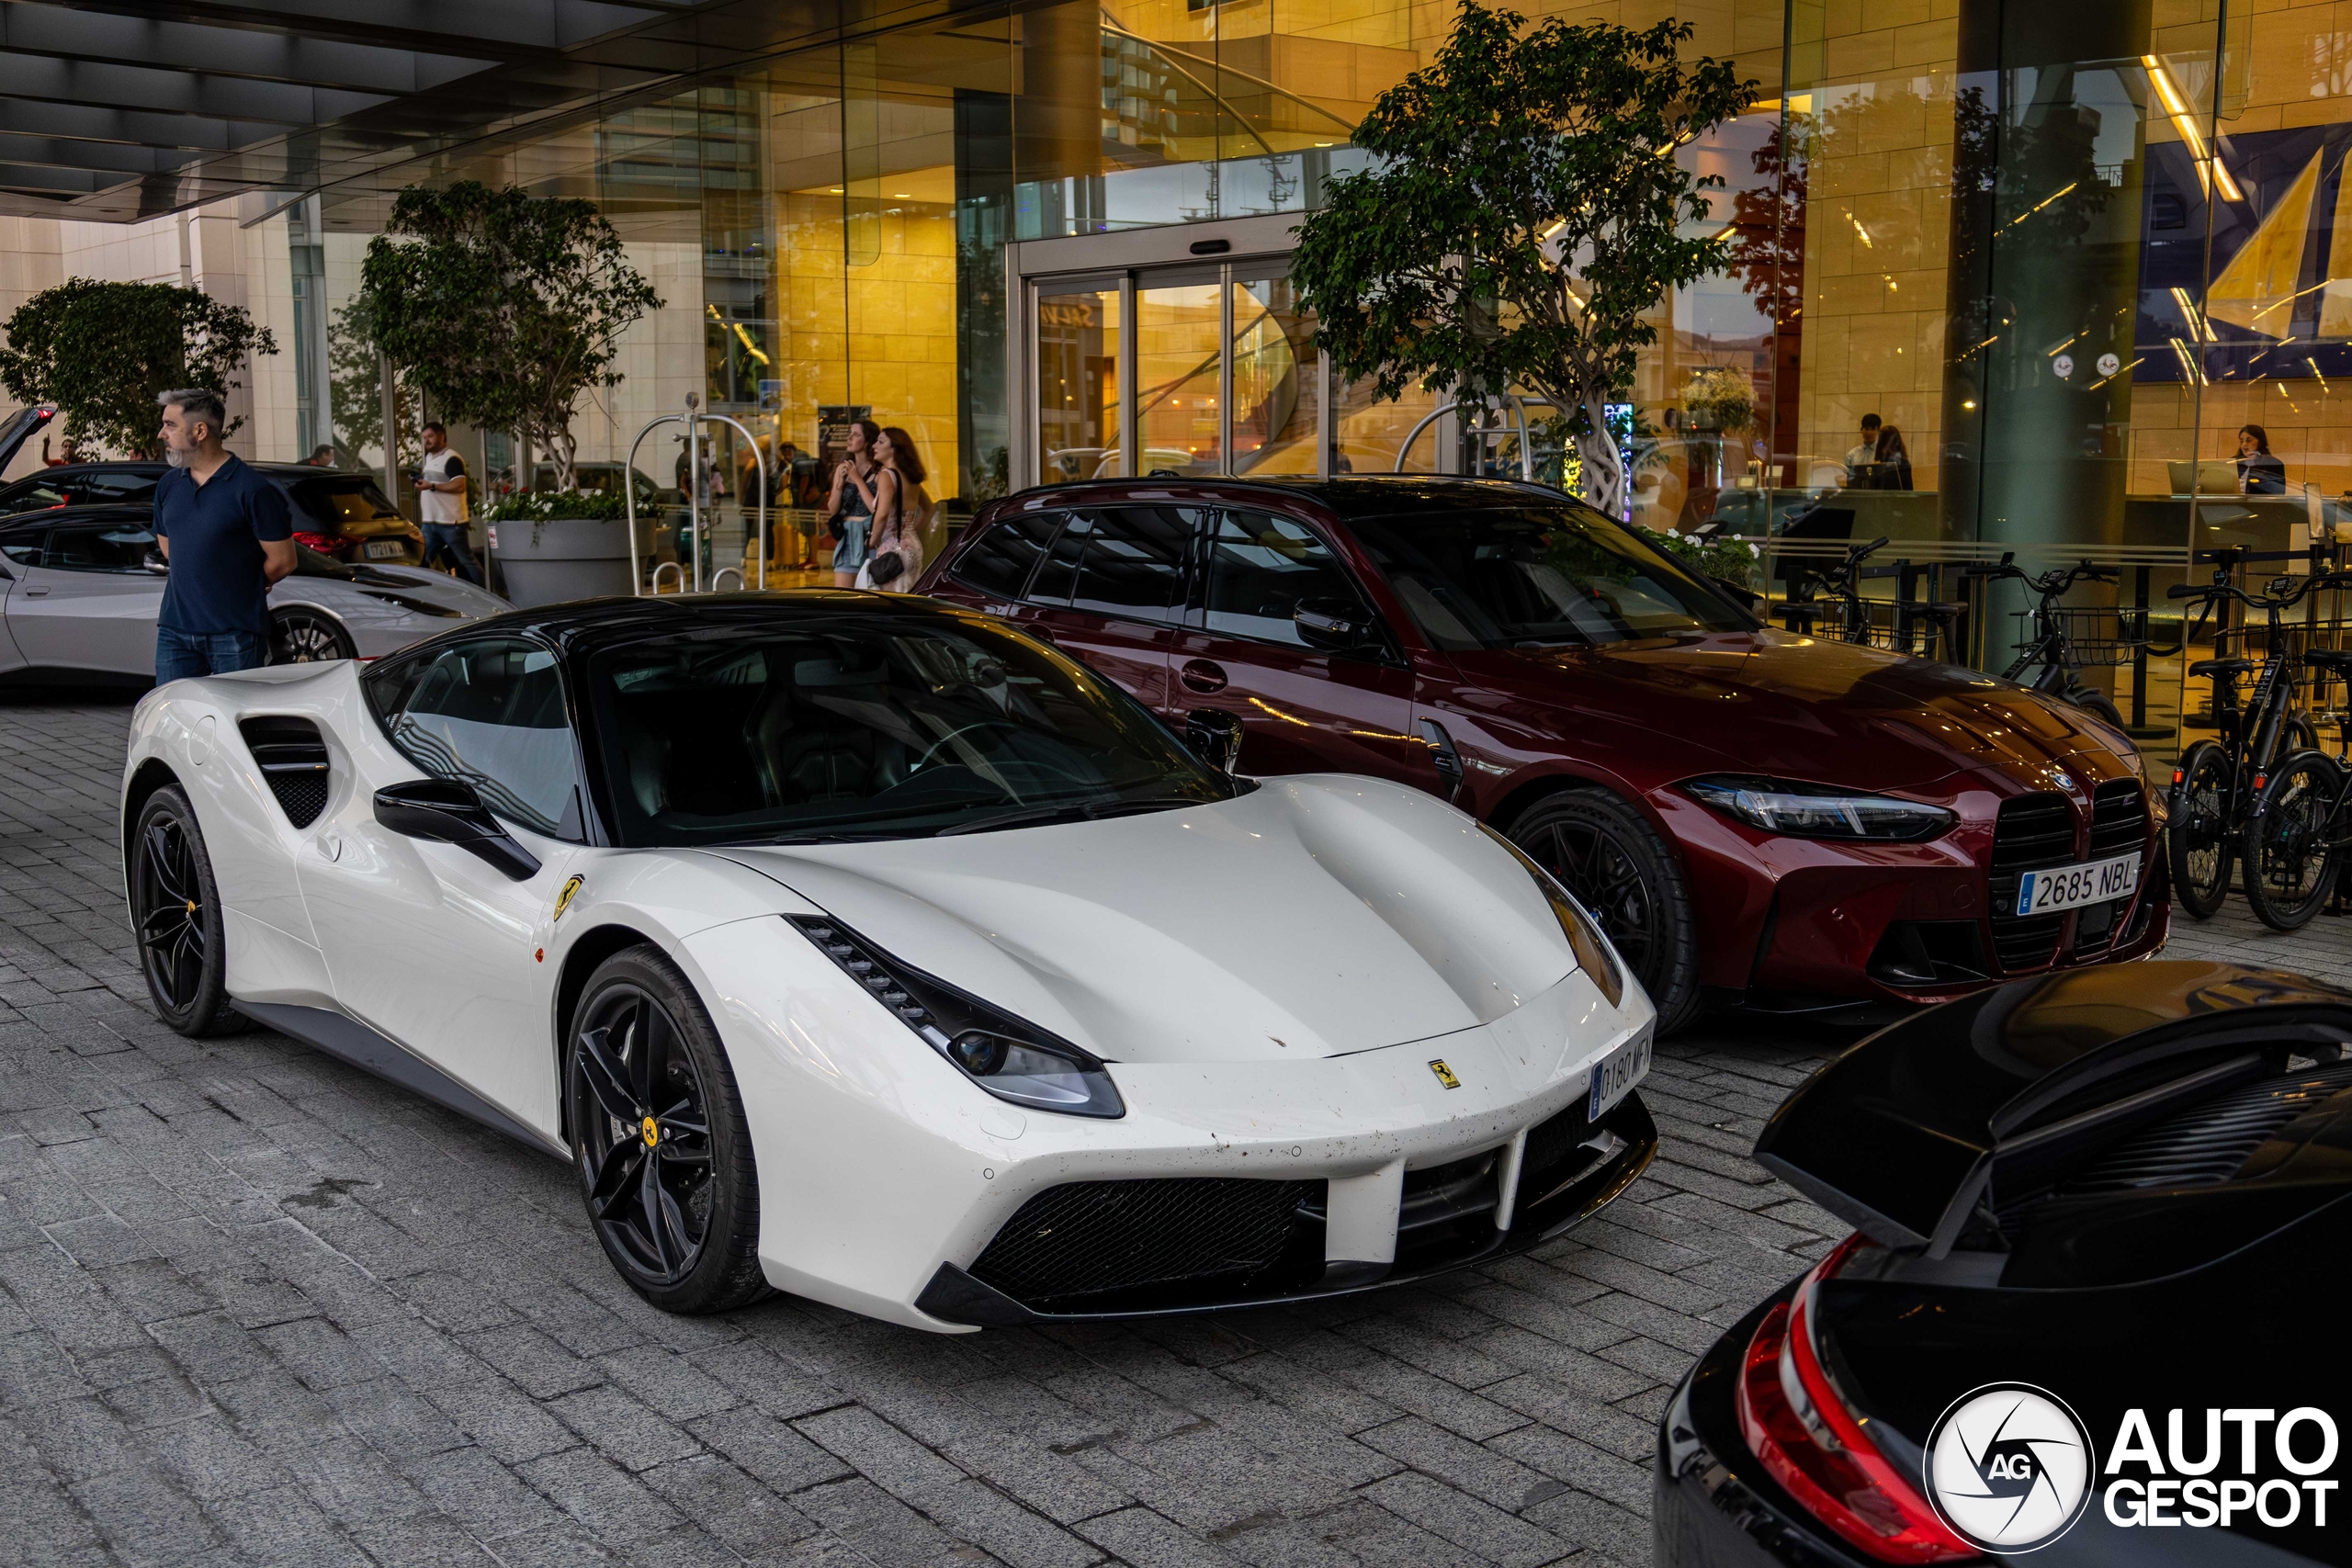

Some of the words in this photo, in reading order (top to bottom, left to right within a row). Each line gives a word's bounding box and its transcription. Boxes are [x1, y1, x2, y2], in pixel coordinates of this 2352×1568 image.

[2022, 897, 2029, 908] E
[2036, 868, 2094, 908] 2685
[2098, 860, 2132, 896] NBL
[1600, 1052, 1632, 1101] 0180
